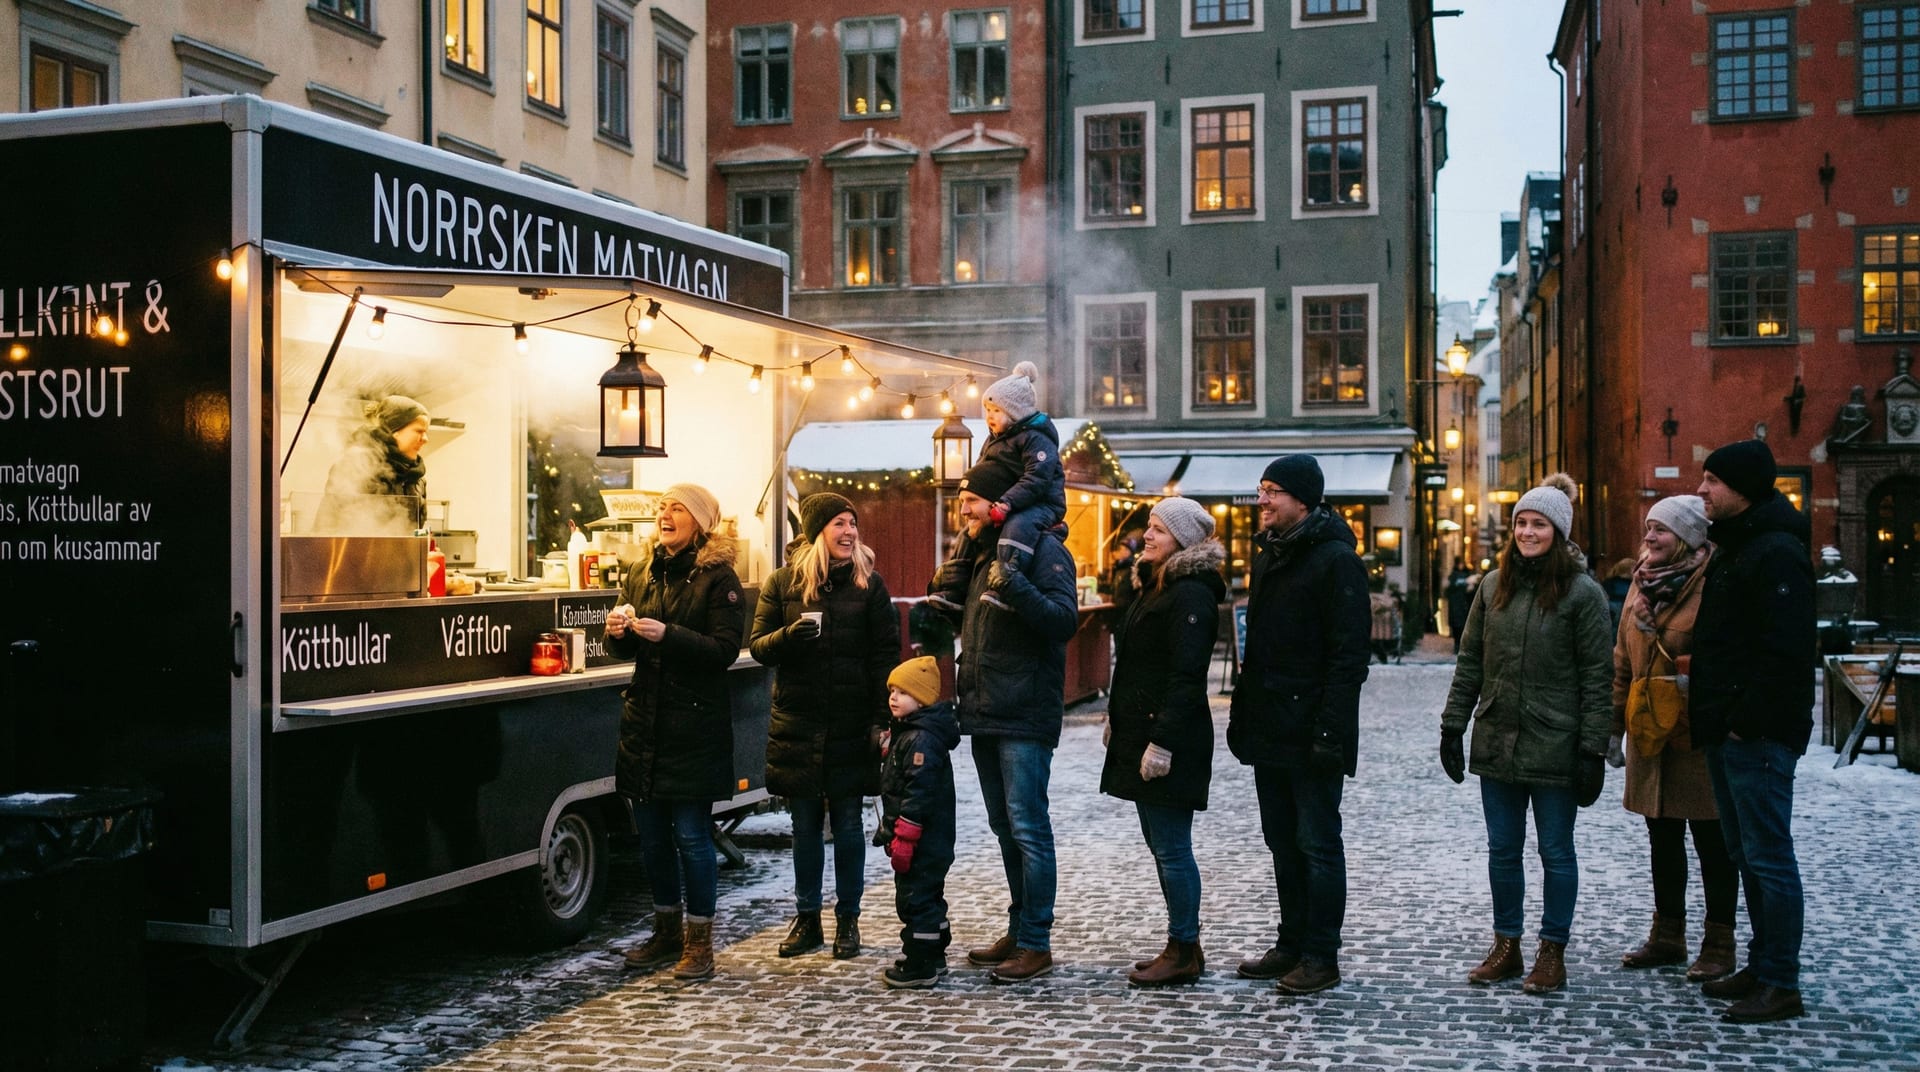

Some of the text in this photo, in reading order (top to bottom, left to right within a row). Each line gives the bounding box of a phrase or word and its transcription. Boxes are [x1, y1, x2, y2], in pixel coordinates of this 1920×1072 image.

[373, 171, 728, 302] NORRSKEN MATVAGN
[143, 279, 170, 334] &
[28, 494, 124, 522] Köttbullar
[129, 502, 151, 522] av
[18, 541, 46, 560] om
[282, 621, 391, 673] Köttbullar
[441, 614, 511, 658] Våfflor
